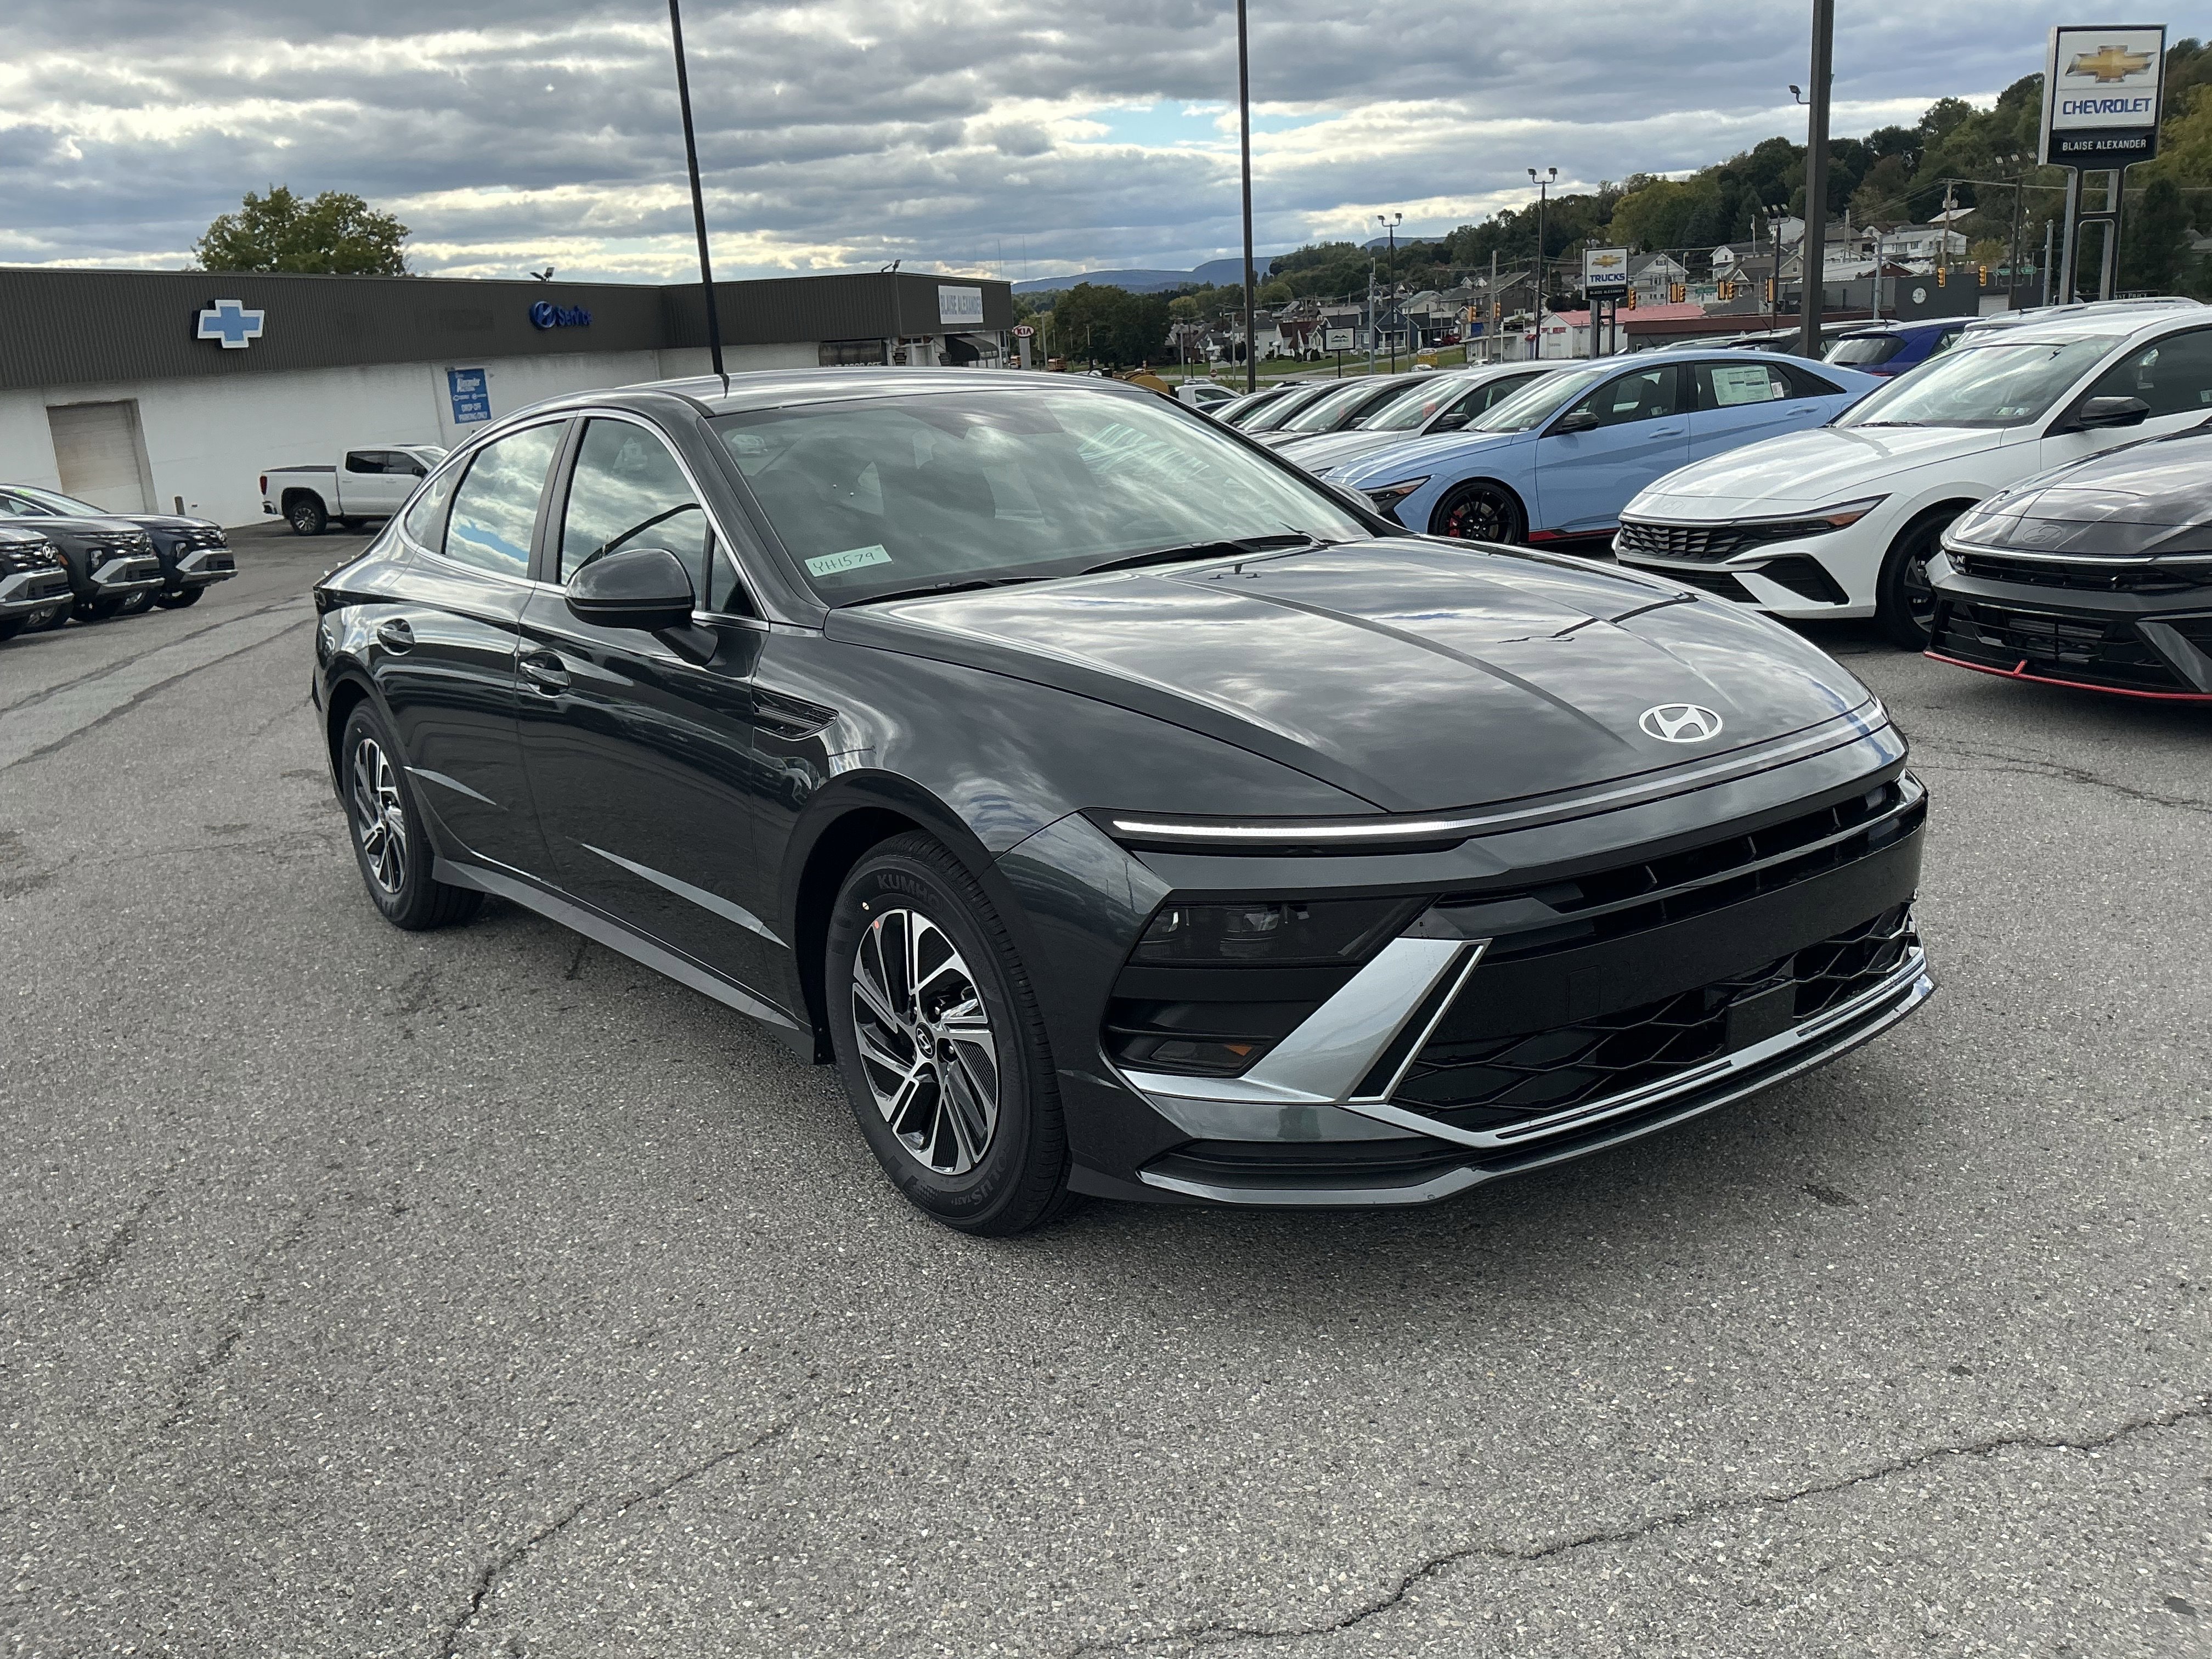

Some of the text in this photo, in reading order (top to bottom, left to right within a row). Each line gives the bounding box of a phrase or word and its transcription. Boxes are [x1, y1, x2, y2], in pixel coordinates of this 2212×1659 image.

[2062, 98, 2152, 115] CHEVROLET
[2062, 139, 2147, 151] BLAISE ALEXANDER
[1589, 273, 1625, 283] TRUCKS
[877, 874, 941, 912] KUMHO
